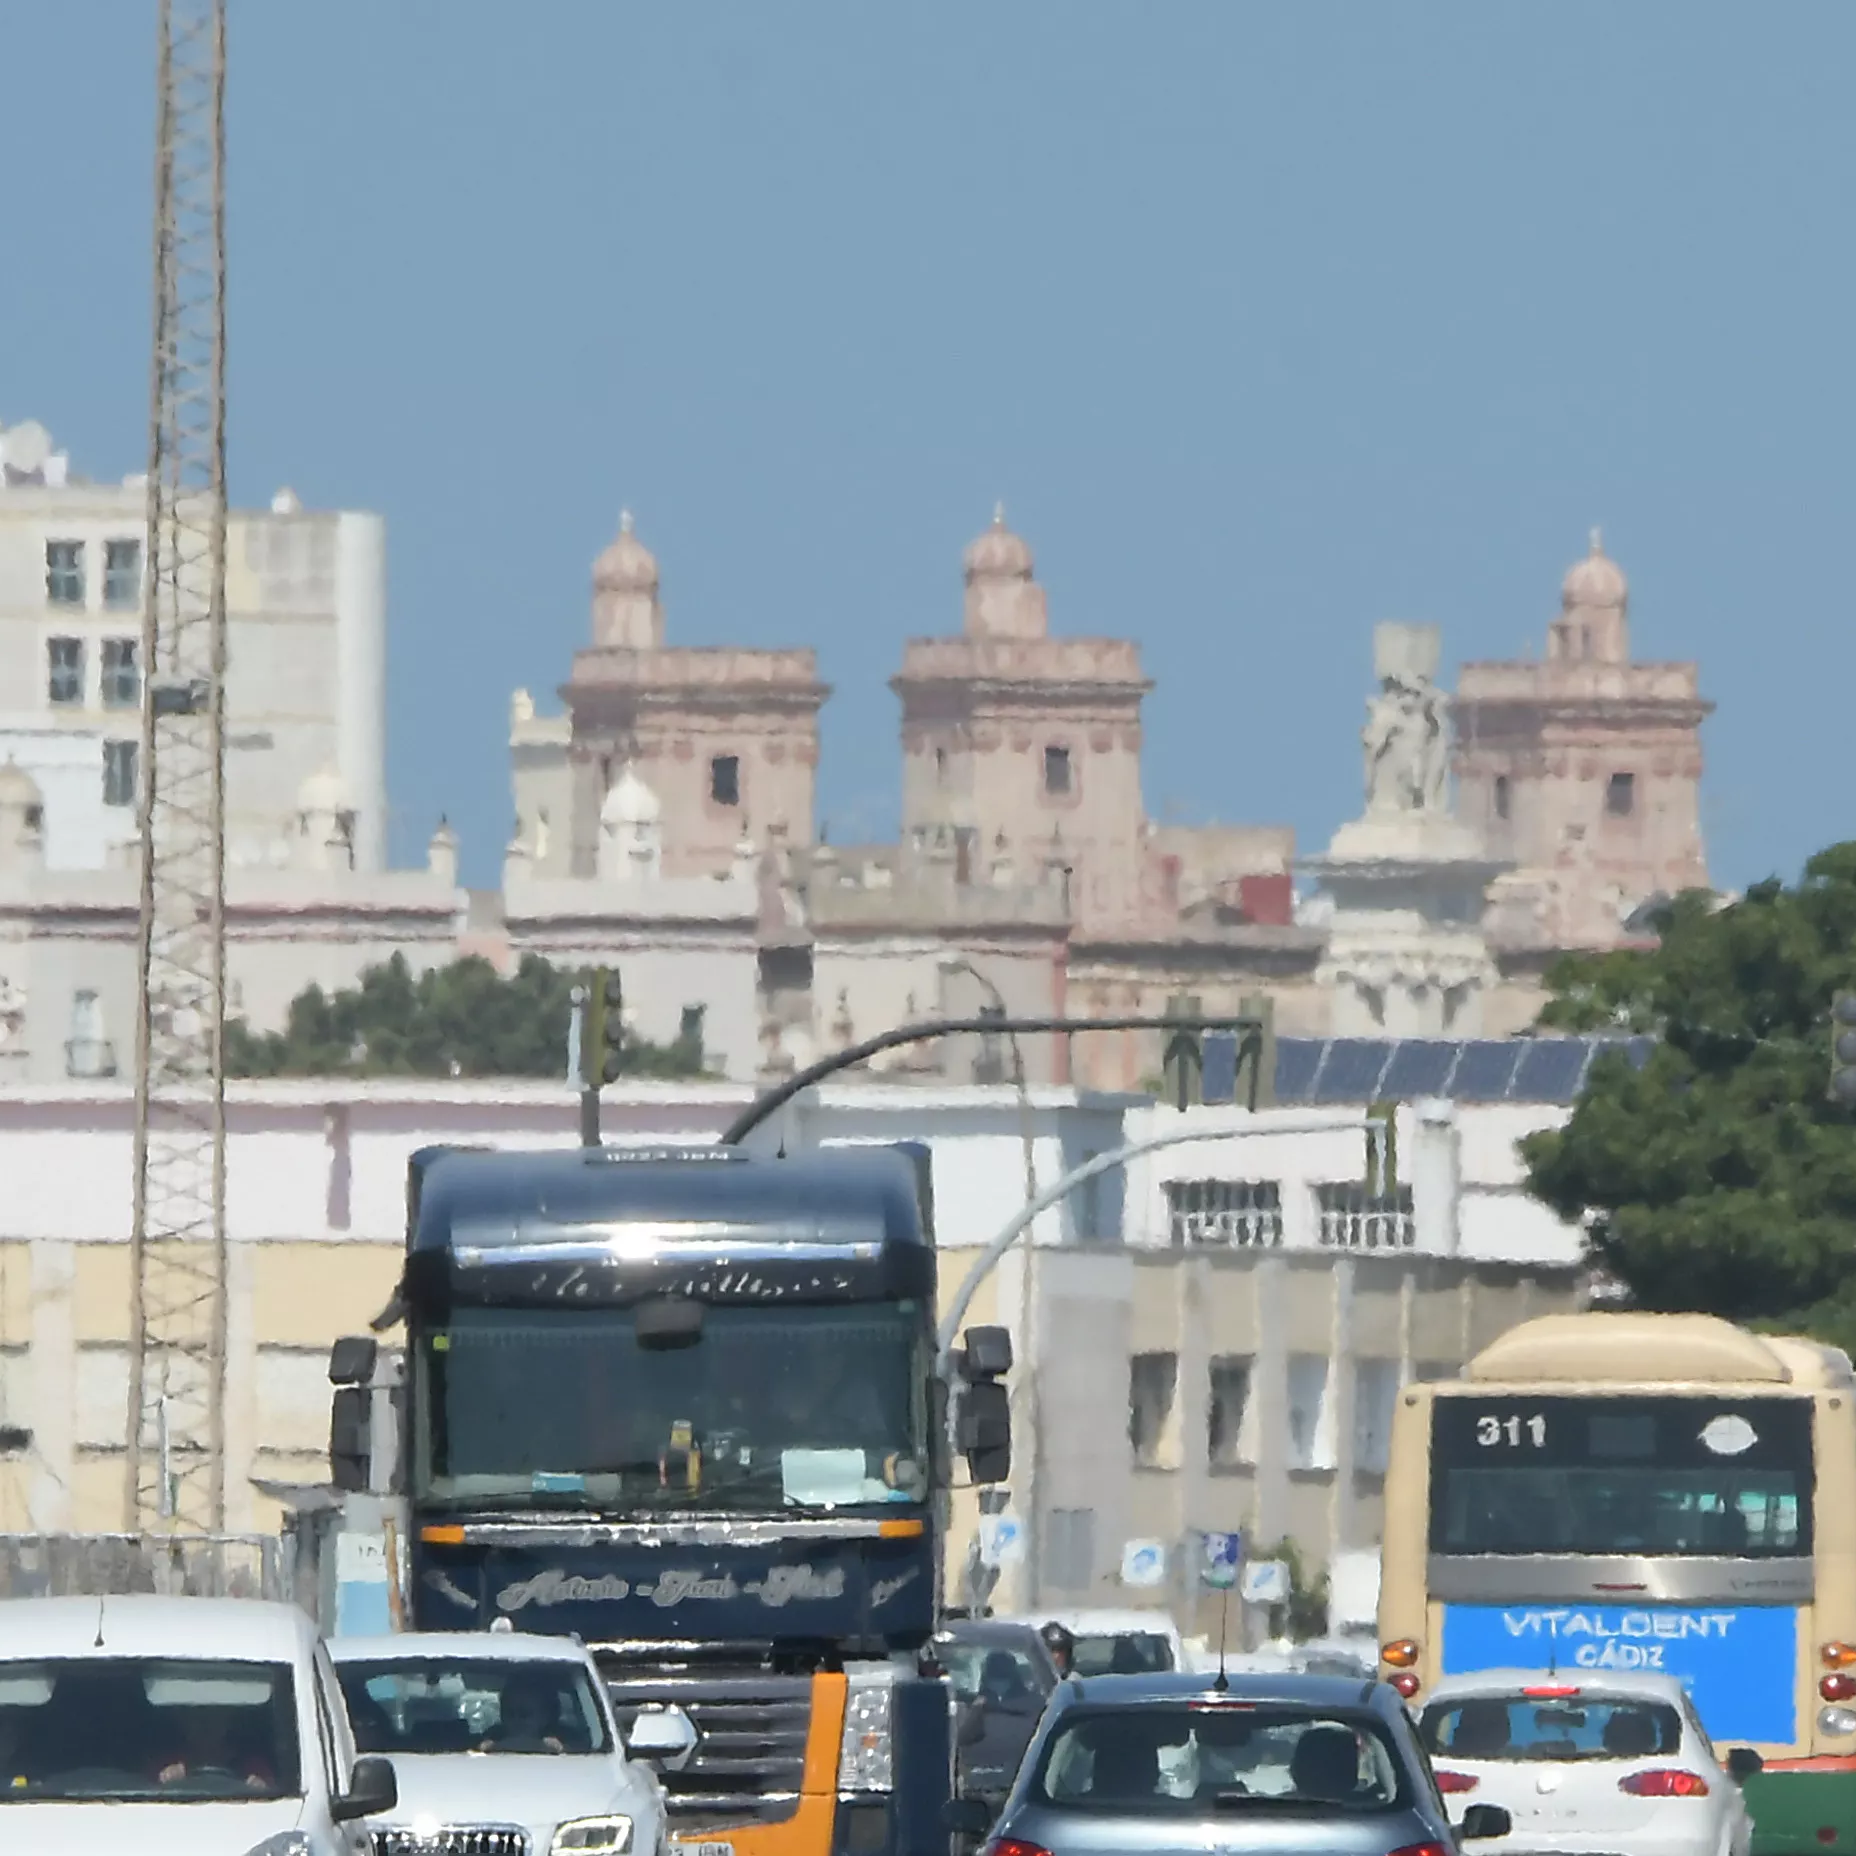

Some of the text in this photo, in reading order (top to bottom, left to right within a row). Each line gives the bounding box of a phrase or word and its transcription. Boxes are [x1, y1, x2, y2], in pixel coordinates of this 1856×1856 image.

[1476, 1414, 1546, 1447] 311
[1503, 1609, 1736, 1638] VITALDENT
[1574, 1638, 1665, 1668] CÁDIZ
